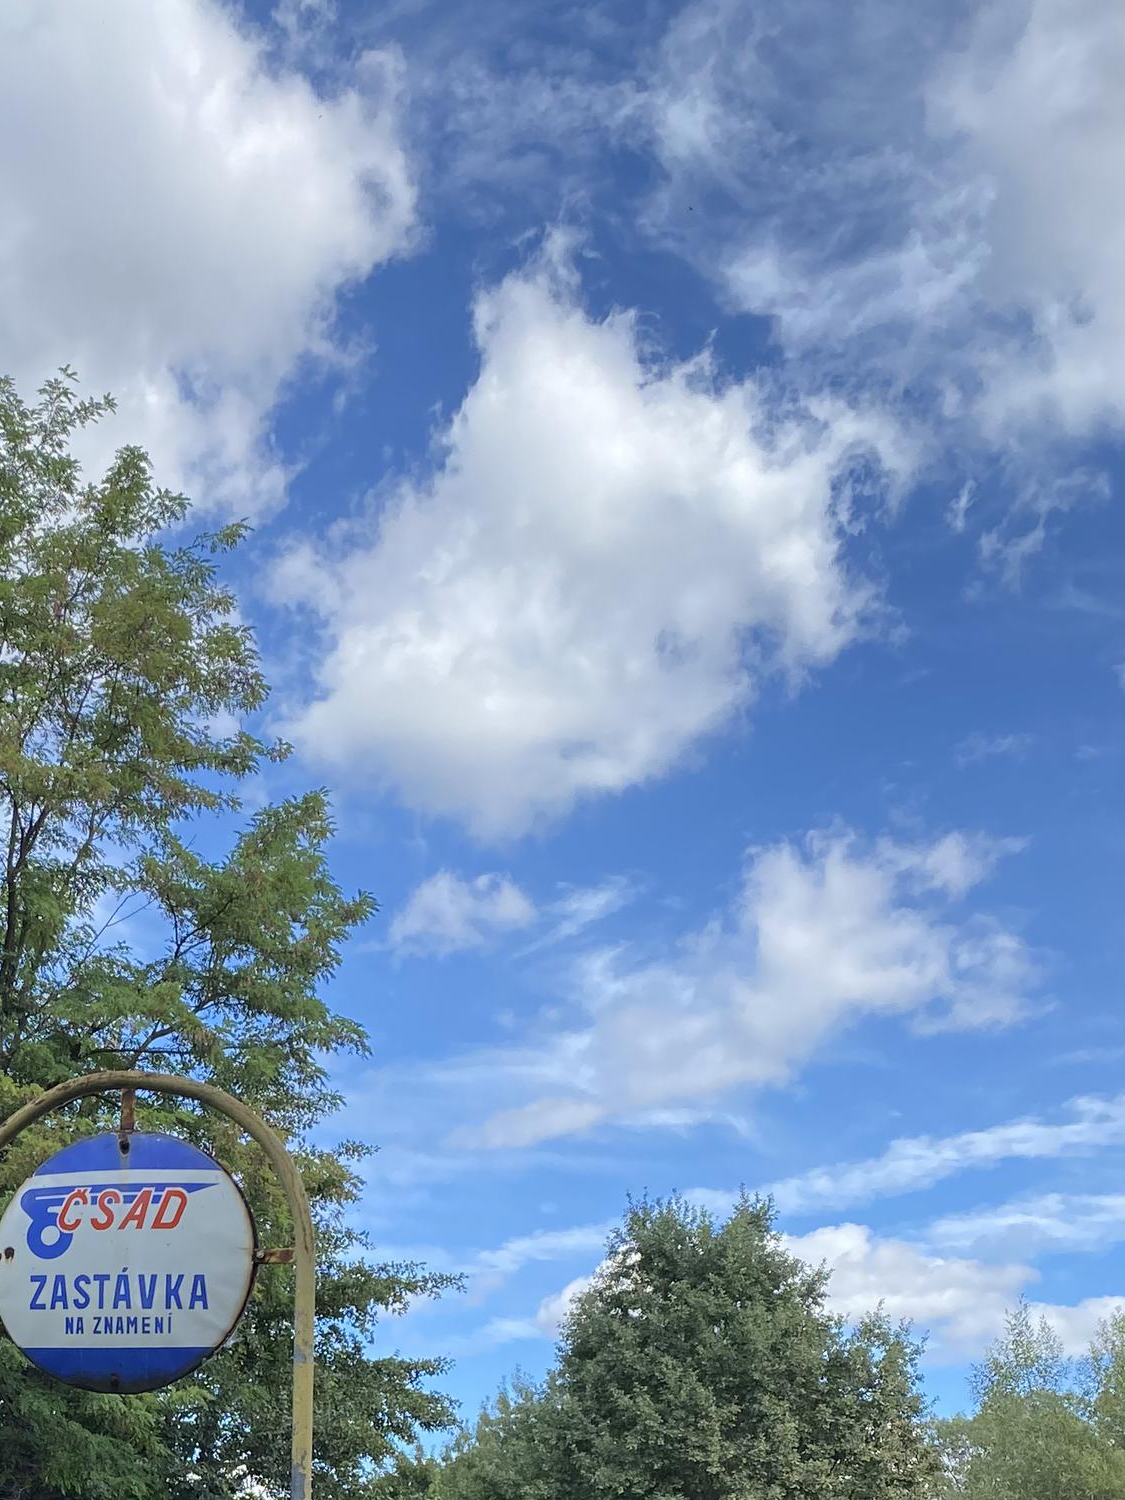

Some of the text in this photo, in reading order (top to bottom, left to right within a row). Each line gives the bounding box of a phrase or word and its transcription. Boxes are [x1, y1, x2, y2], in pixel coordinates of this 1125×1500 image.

[57, 1188, 188, 1231] ČSAD
[29, 1267, 209, 1311] ZASTÁVKA
[65, 1312, 173, 1335] NA ZNAMENÍ
